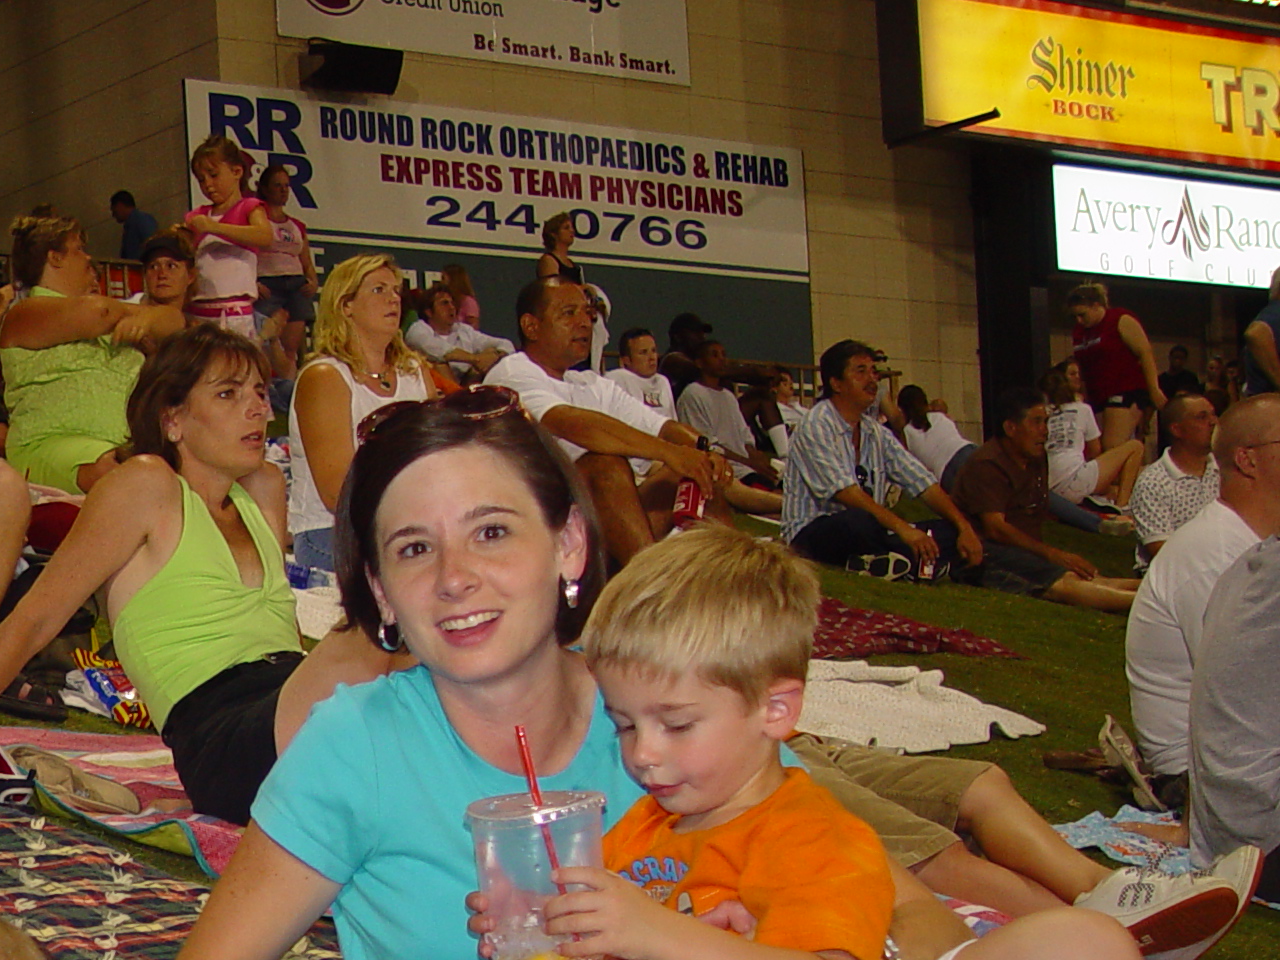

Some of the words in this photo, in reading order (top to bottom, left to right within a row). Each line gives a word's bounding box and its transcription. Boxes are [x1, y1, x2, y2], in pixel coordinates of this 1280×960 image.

[449, 0, 504, 17] Union
[474, 33, 494, 51] Be
[502, 38, 563, 60] Smart.
[569, 46, 615, 67] Bank
[619, 53, 676, 75] Smart.
[1026, 36, 1136, 99] Shiner
[1052, 99, 1117, 121] BOCK
[320, 106, 414, 147] ROUND
[421, 117, 494, 156] ROCK
[500, 126, 686, 176] ORTHOPAEDICS
[693, 152, 710, 179] &
[715, 151, 789, 188] REHAB
[380, 153, 503, 193] EXPRESS
[509, 166, 582, 200] TEAM
[589, 175, 743, 217] PHYSICIANS
[426, 195, 708, 250] 2440766
[1071, 187, 1162, 250] Avery
[1100, 252, 1175, 278] GOLF
[1205, 263, 1275, 287] CLU
